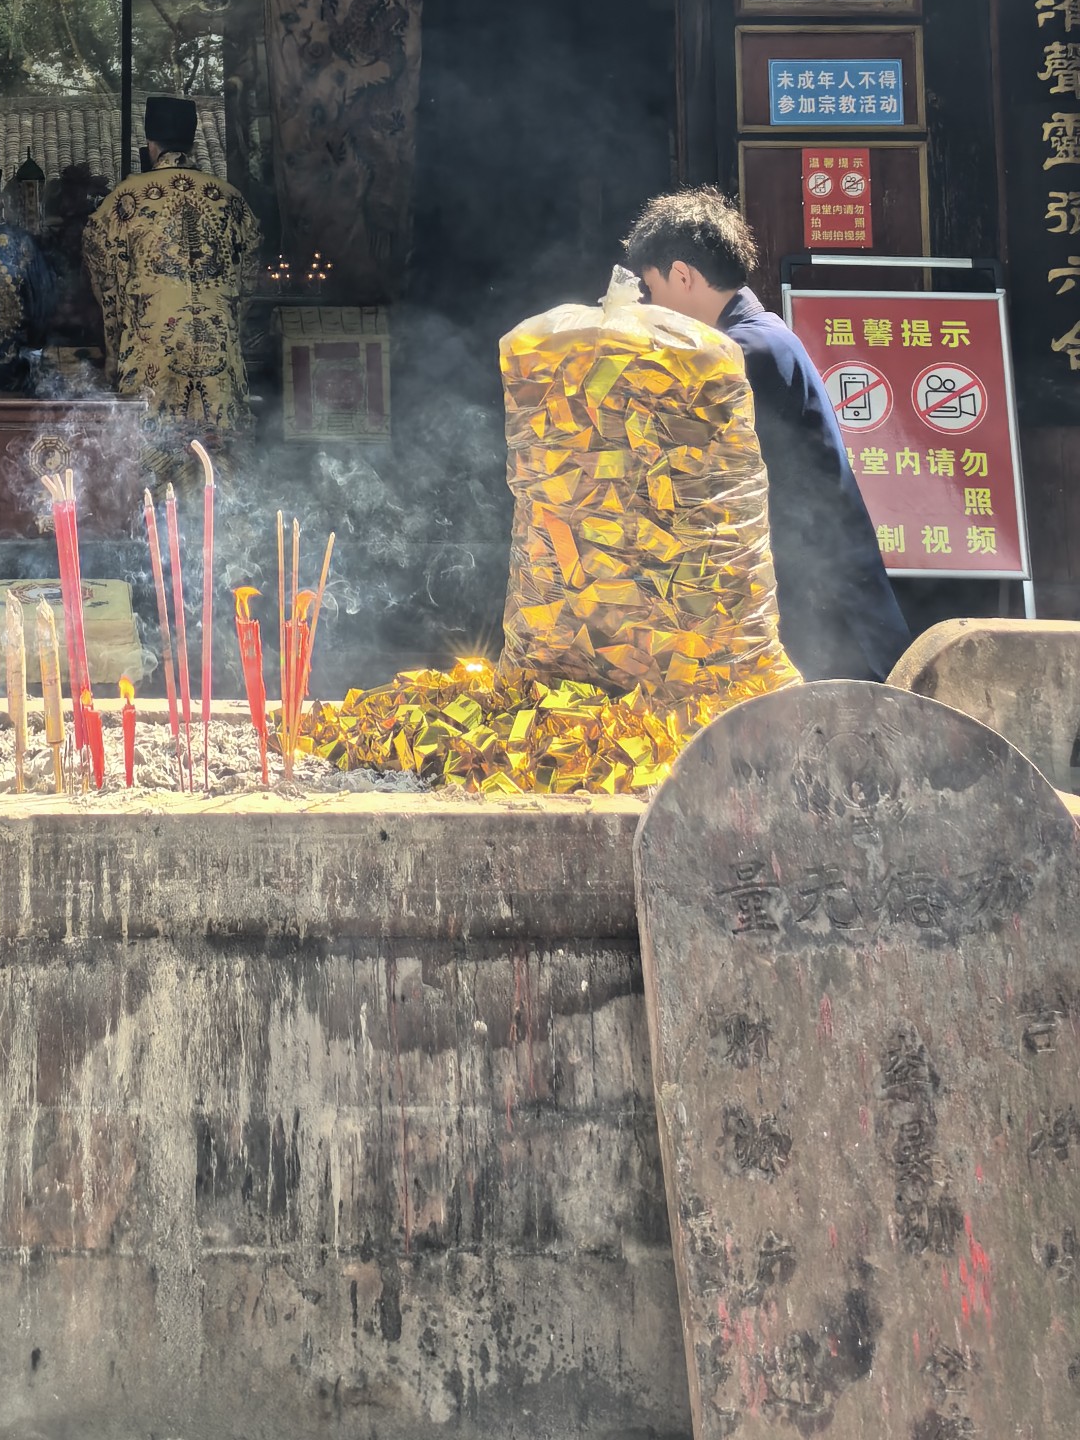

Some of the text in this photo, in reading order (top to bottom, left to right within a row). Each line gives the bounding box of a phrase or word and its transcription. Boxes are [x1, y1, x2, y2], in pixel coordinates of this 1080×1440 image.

[776, 69, 897, 92] 未成年人不得
[777, 93, 899, 116] 参加宗教活动
[808, 157, 864, 169] 温馨提示
[810, 204, 865, 215] 殿堂内请勿
[824, 318, 972, 348] 温馨提示
[964, 487, 995, 516] 照
